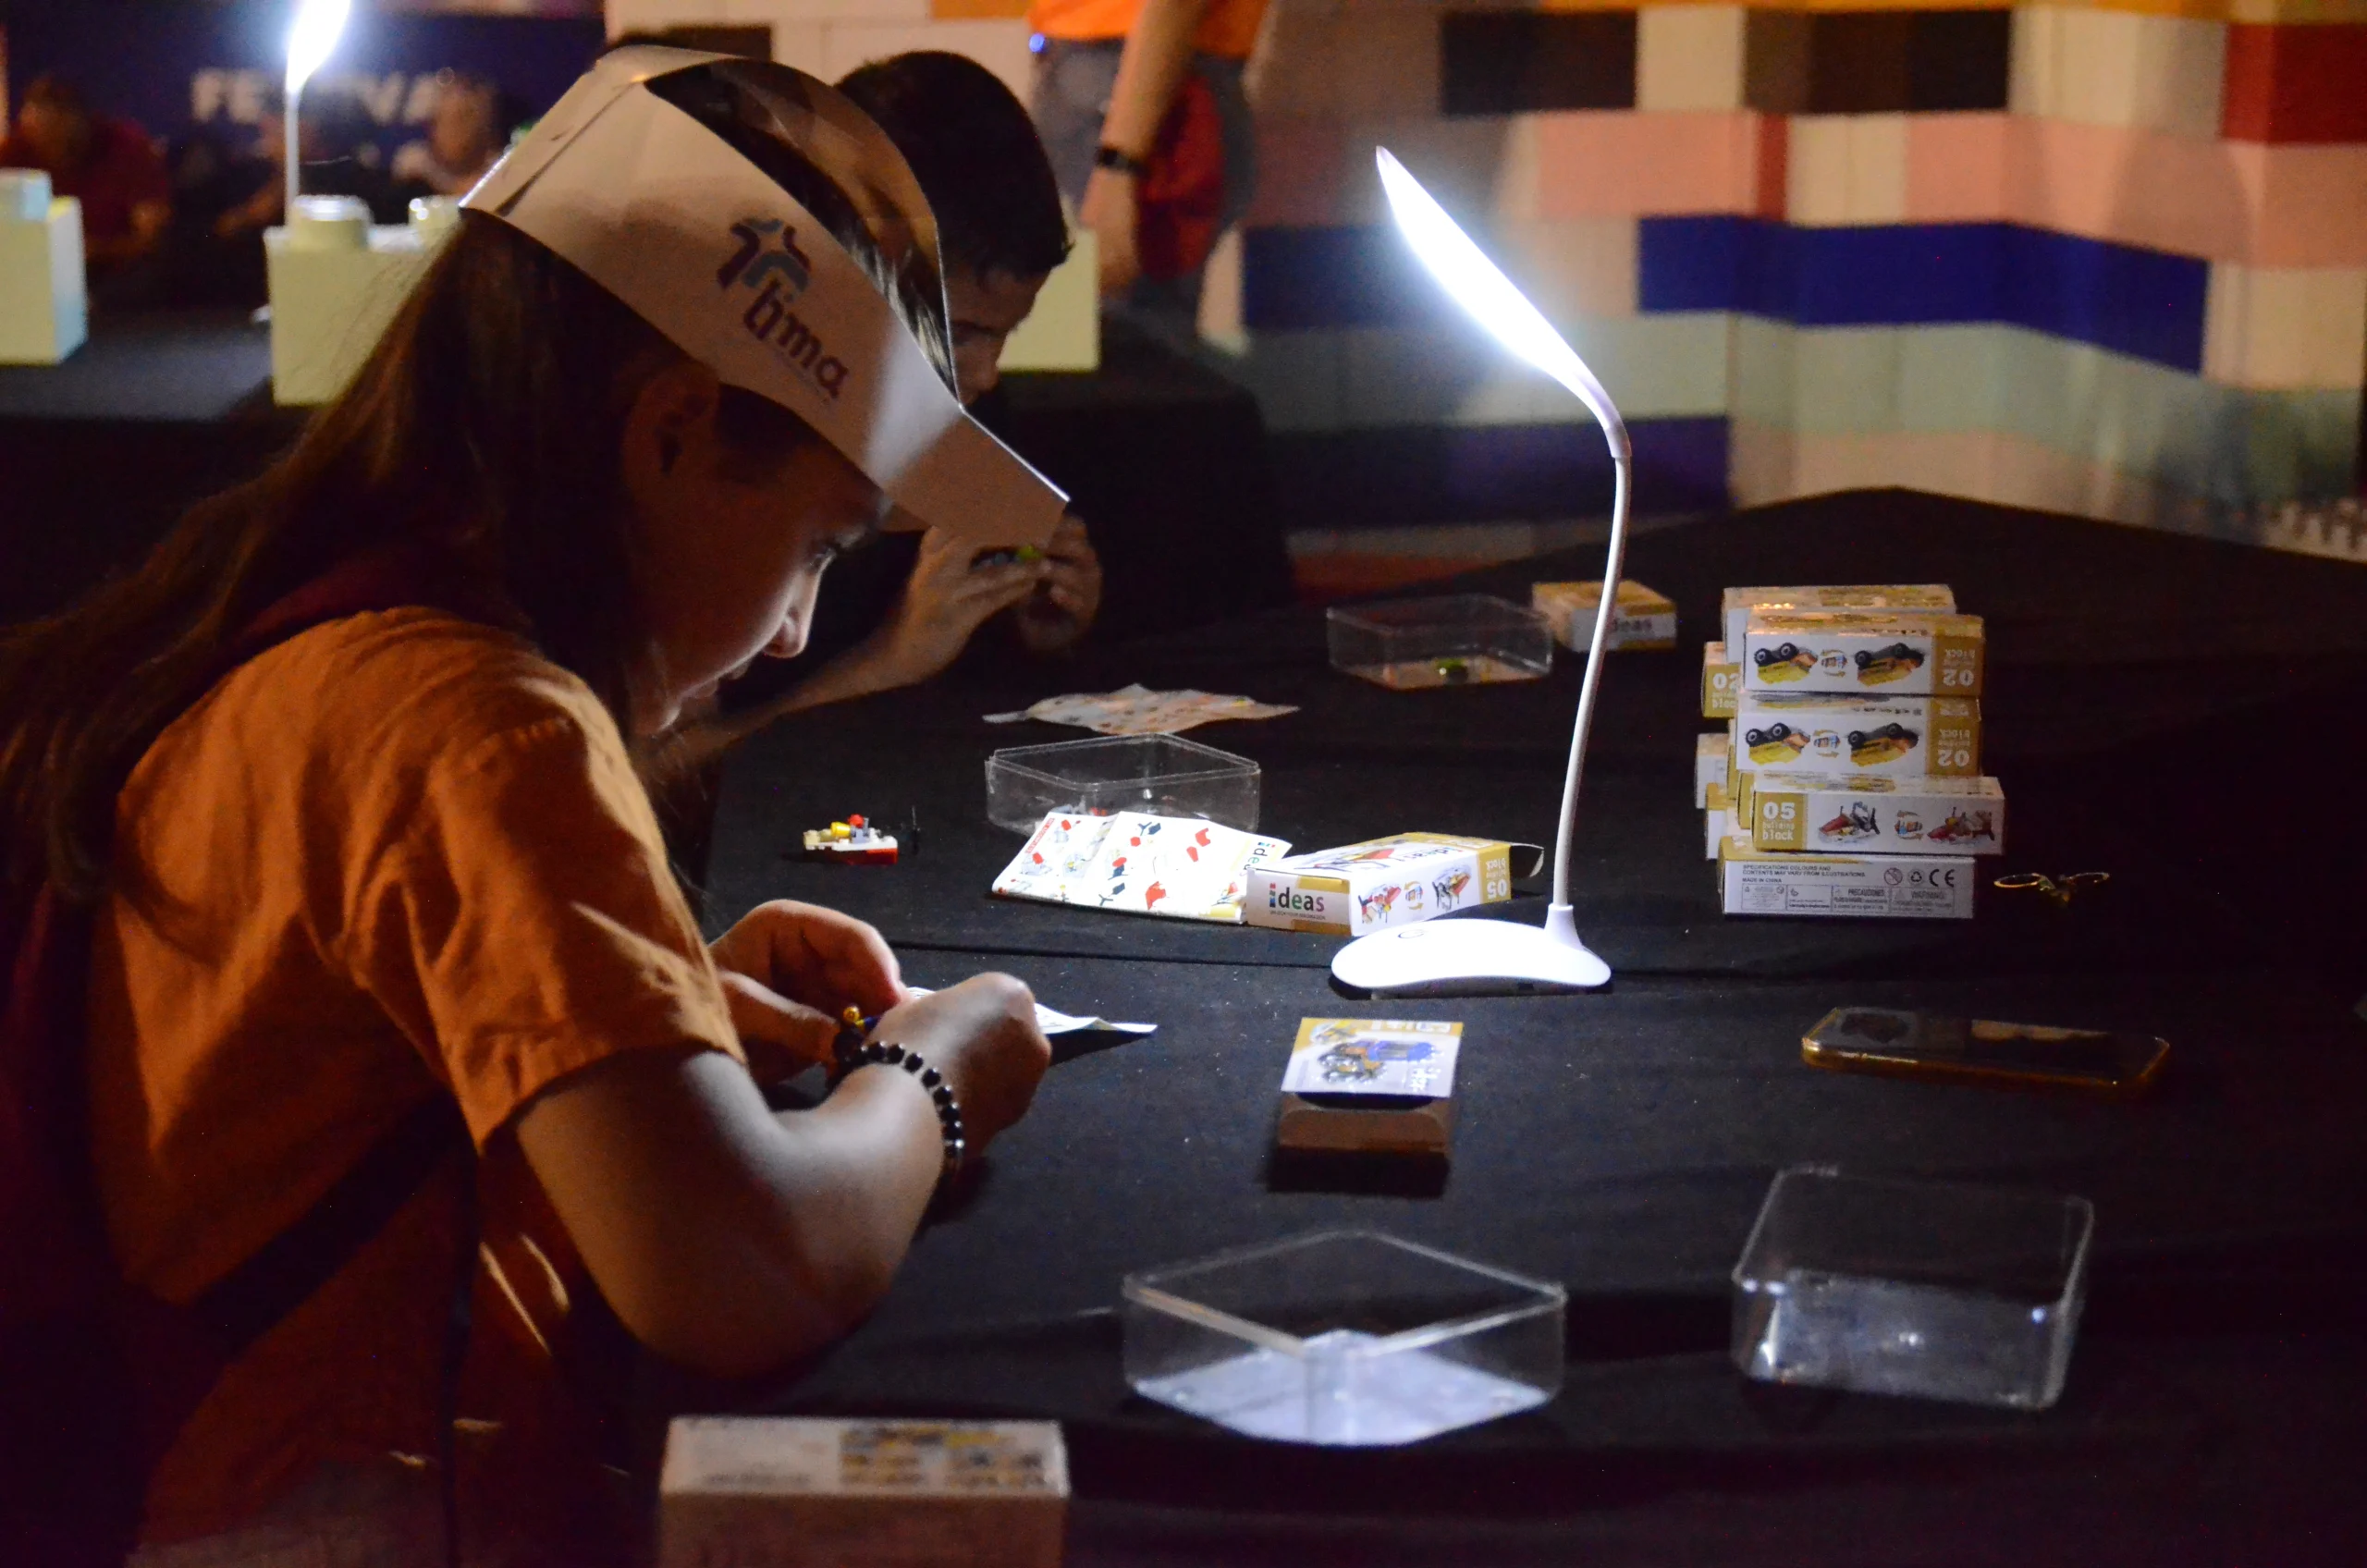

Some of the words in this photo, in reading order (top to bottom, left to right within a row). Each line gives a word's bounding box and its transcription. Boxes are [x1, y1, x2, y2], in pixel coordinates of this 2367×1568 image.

[1943, 668, 1975, 687] 02
[1938, 749, 1970, 767] 02
[1763, 802, 1796, 820] 05
[1762, 830, 1794, 840] block
[1269, 882, 1325, 913] ideas
[1487, 879, 1507, 900] 05
